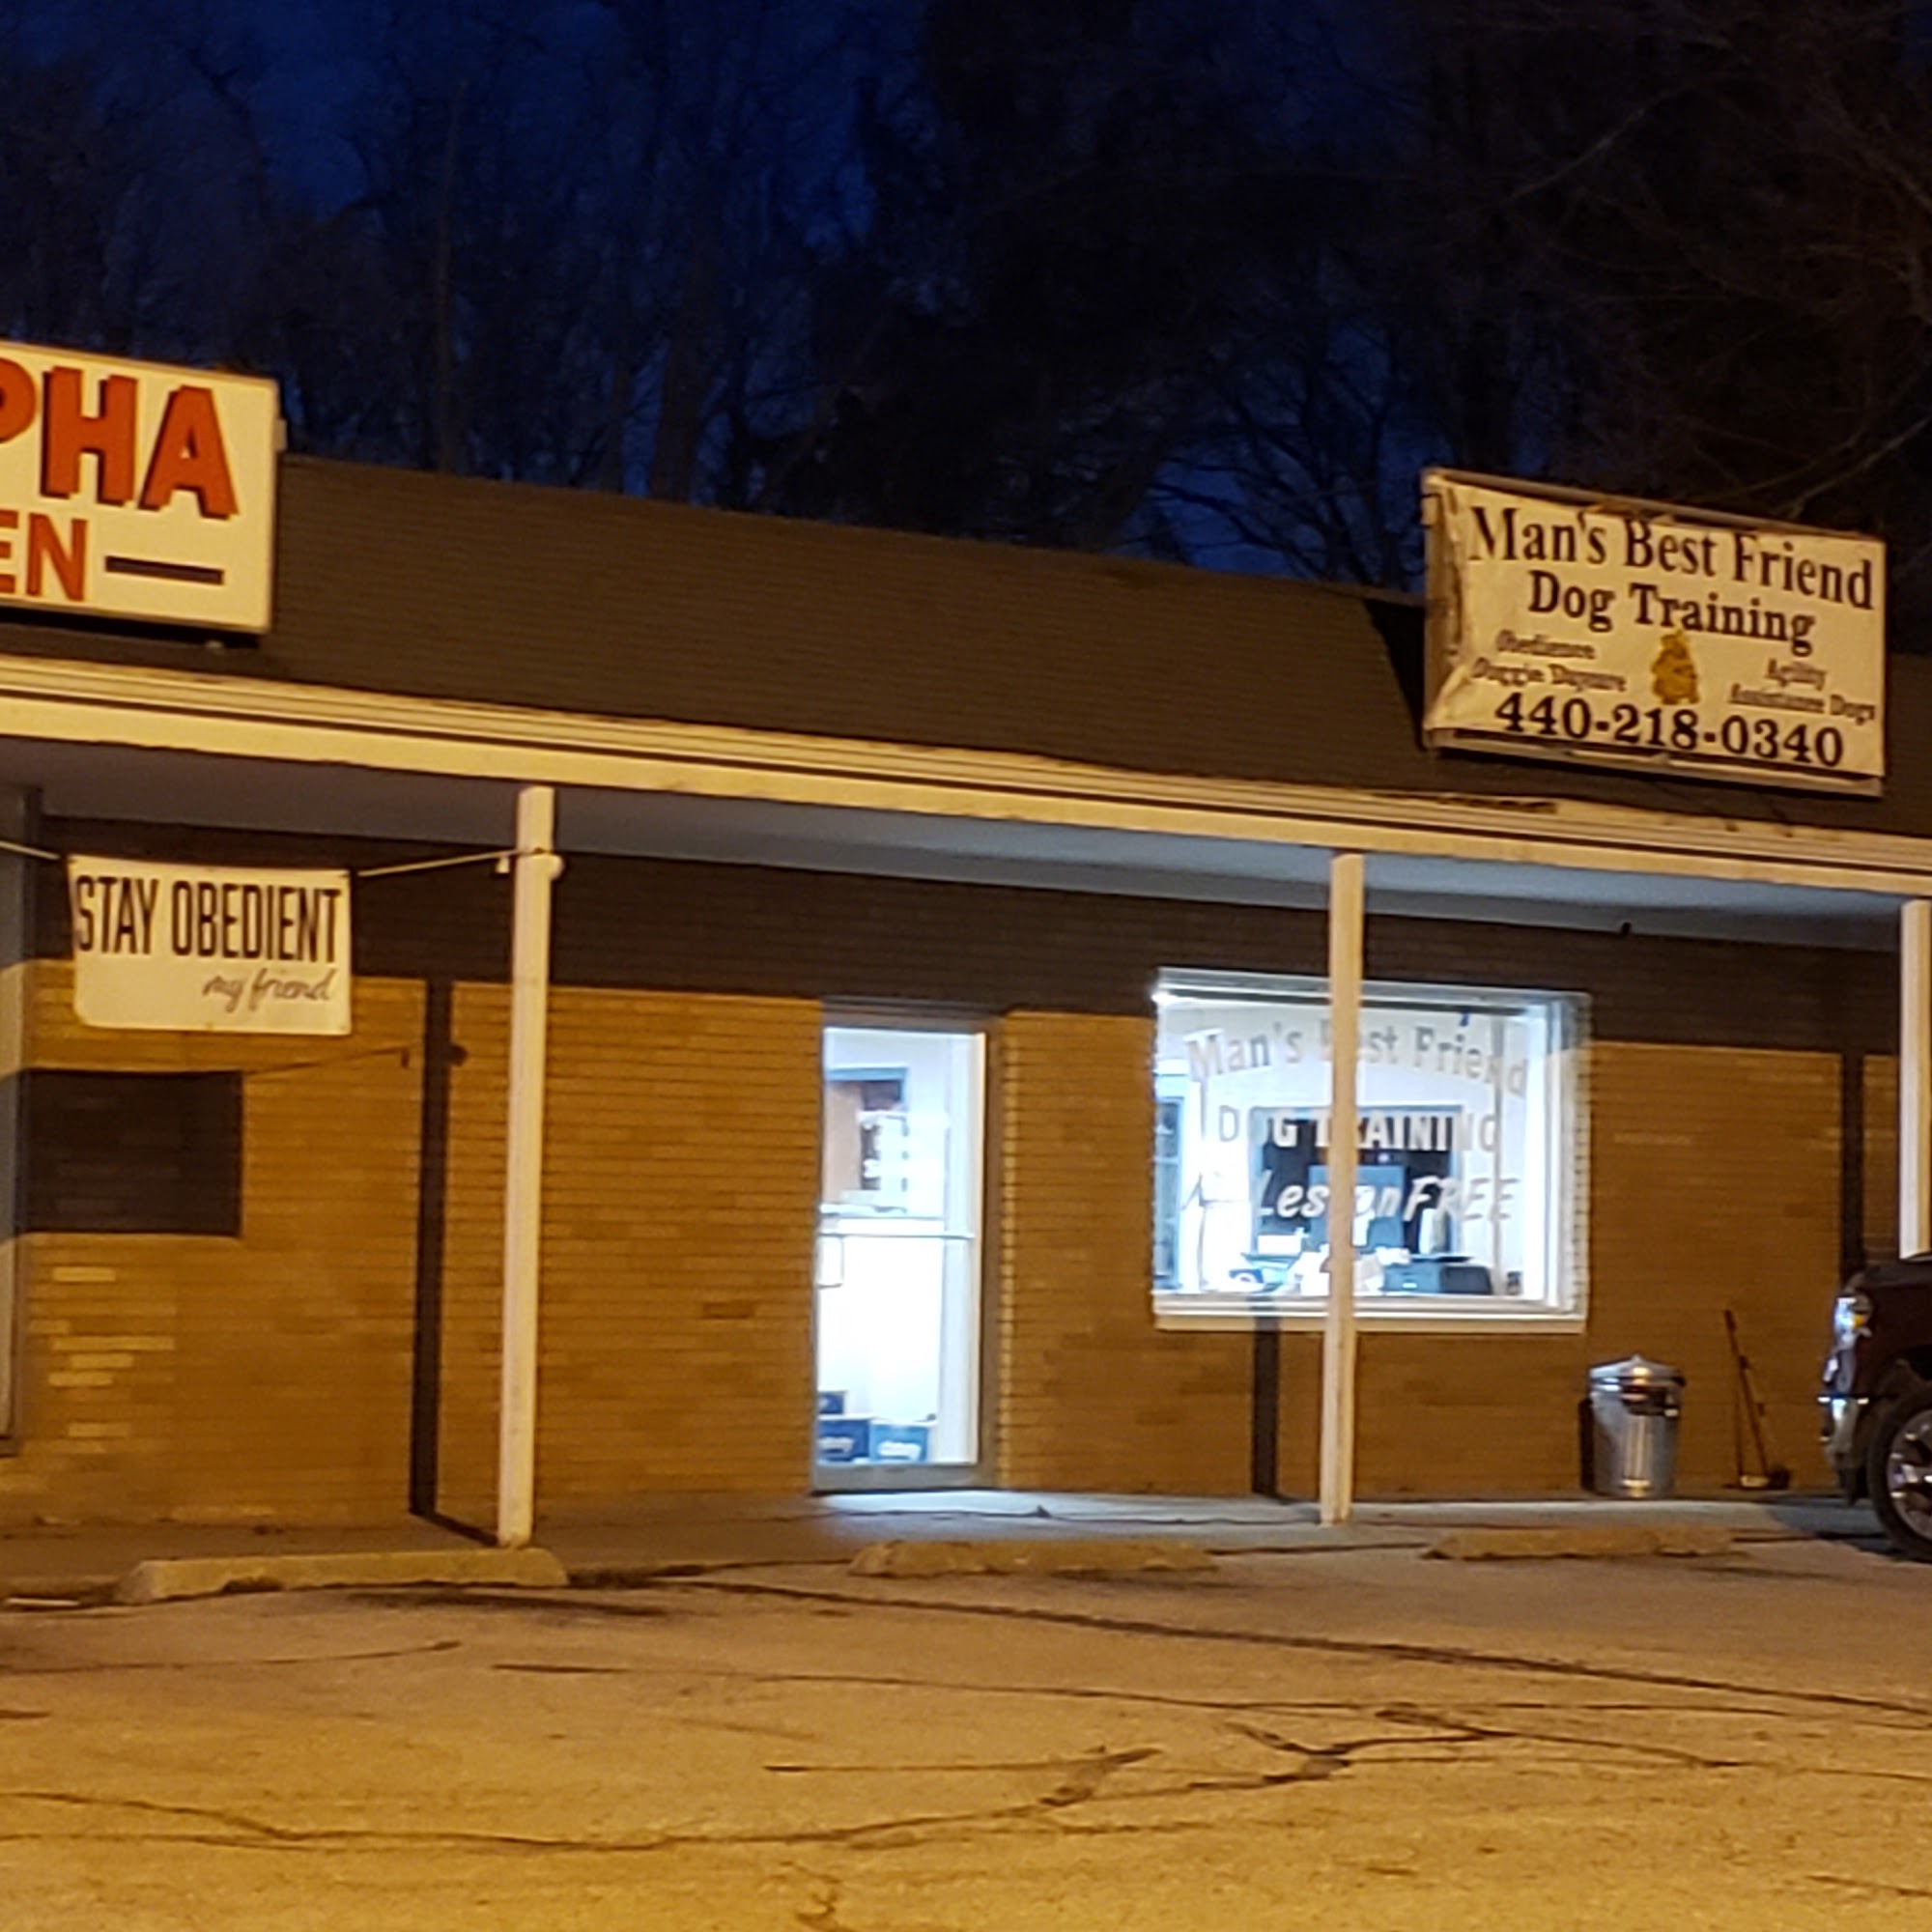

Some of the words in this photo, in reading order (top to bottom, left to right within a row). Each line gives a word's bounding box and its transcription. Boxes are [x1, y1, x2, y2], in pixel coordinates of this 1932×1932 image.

[1469, 504, 1607, 567] Man's
[1624, 518, 1719, 579] Best
[1734, 532, 1875, 611] Friend
[1528, 570, 1616, 633] Dog
[1629, 582, 1816, 657] Training
[1495, 692, 1844, 767] 440-218-0340
[75, 874, 160, 954] STAY
[171, 879, 342, 963] OBEDIENT
[201, 974, 247, 1014] my
[247, 967, 337, 1012] friend
[1186, 1020, 1302, 1080] Man's
[1313, 1110, 1499, 1153] TAINING
[1256, 1169, 1402, 1218] Leson
[1403, 1175, 1521, 1222] FREE
